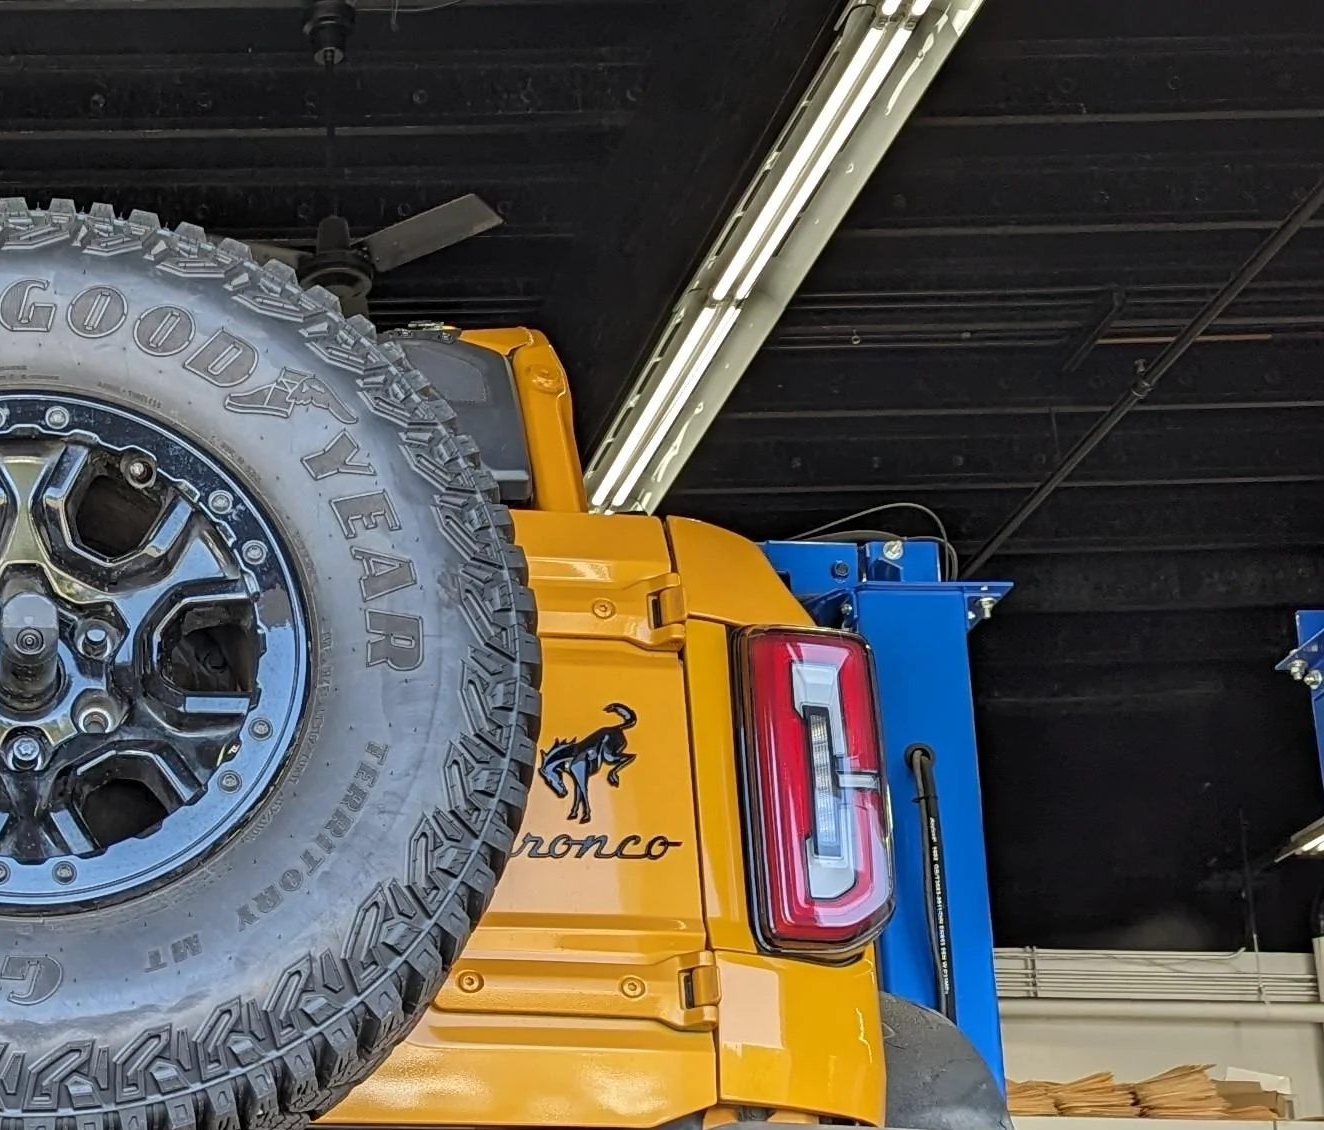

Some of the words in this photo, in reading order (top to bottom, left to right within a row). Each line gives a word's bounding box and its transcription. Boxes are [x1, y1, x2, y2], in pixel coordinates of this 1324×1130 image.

[236, 741, 389, 931] TERRITORY
[510, 832, 683, 860] ronco
[145, 933, 202, 973] MT
